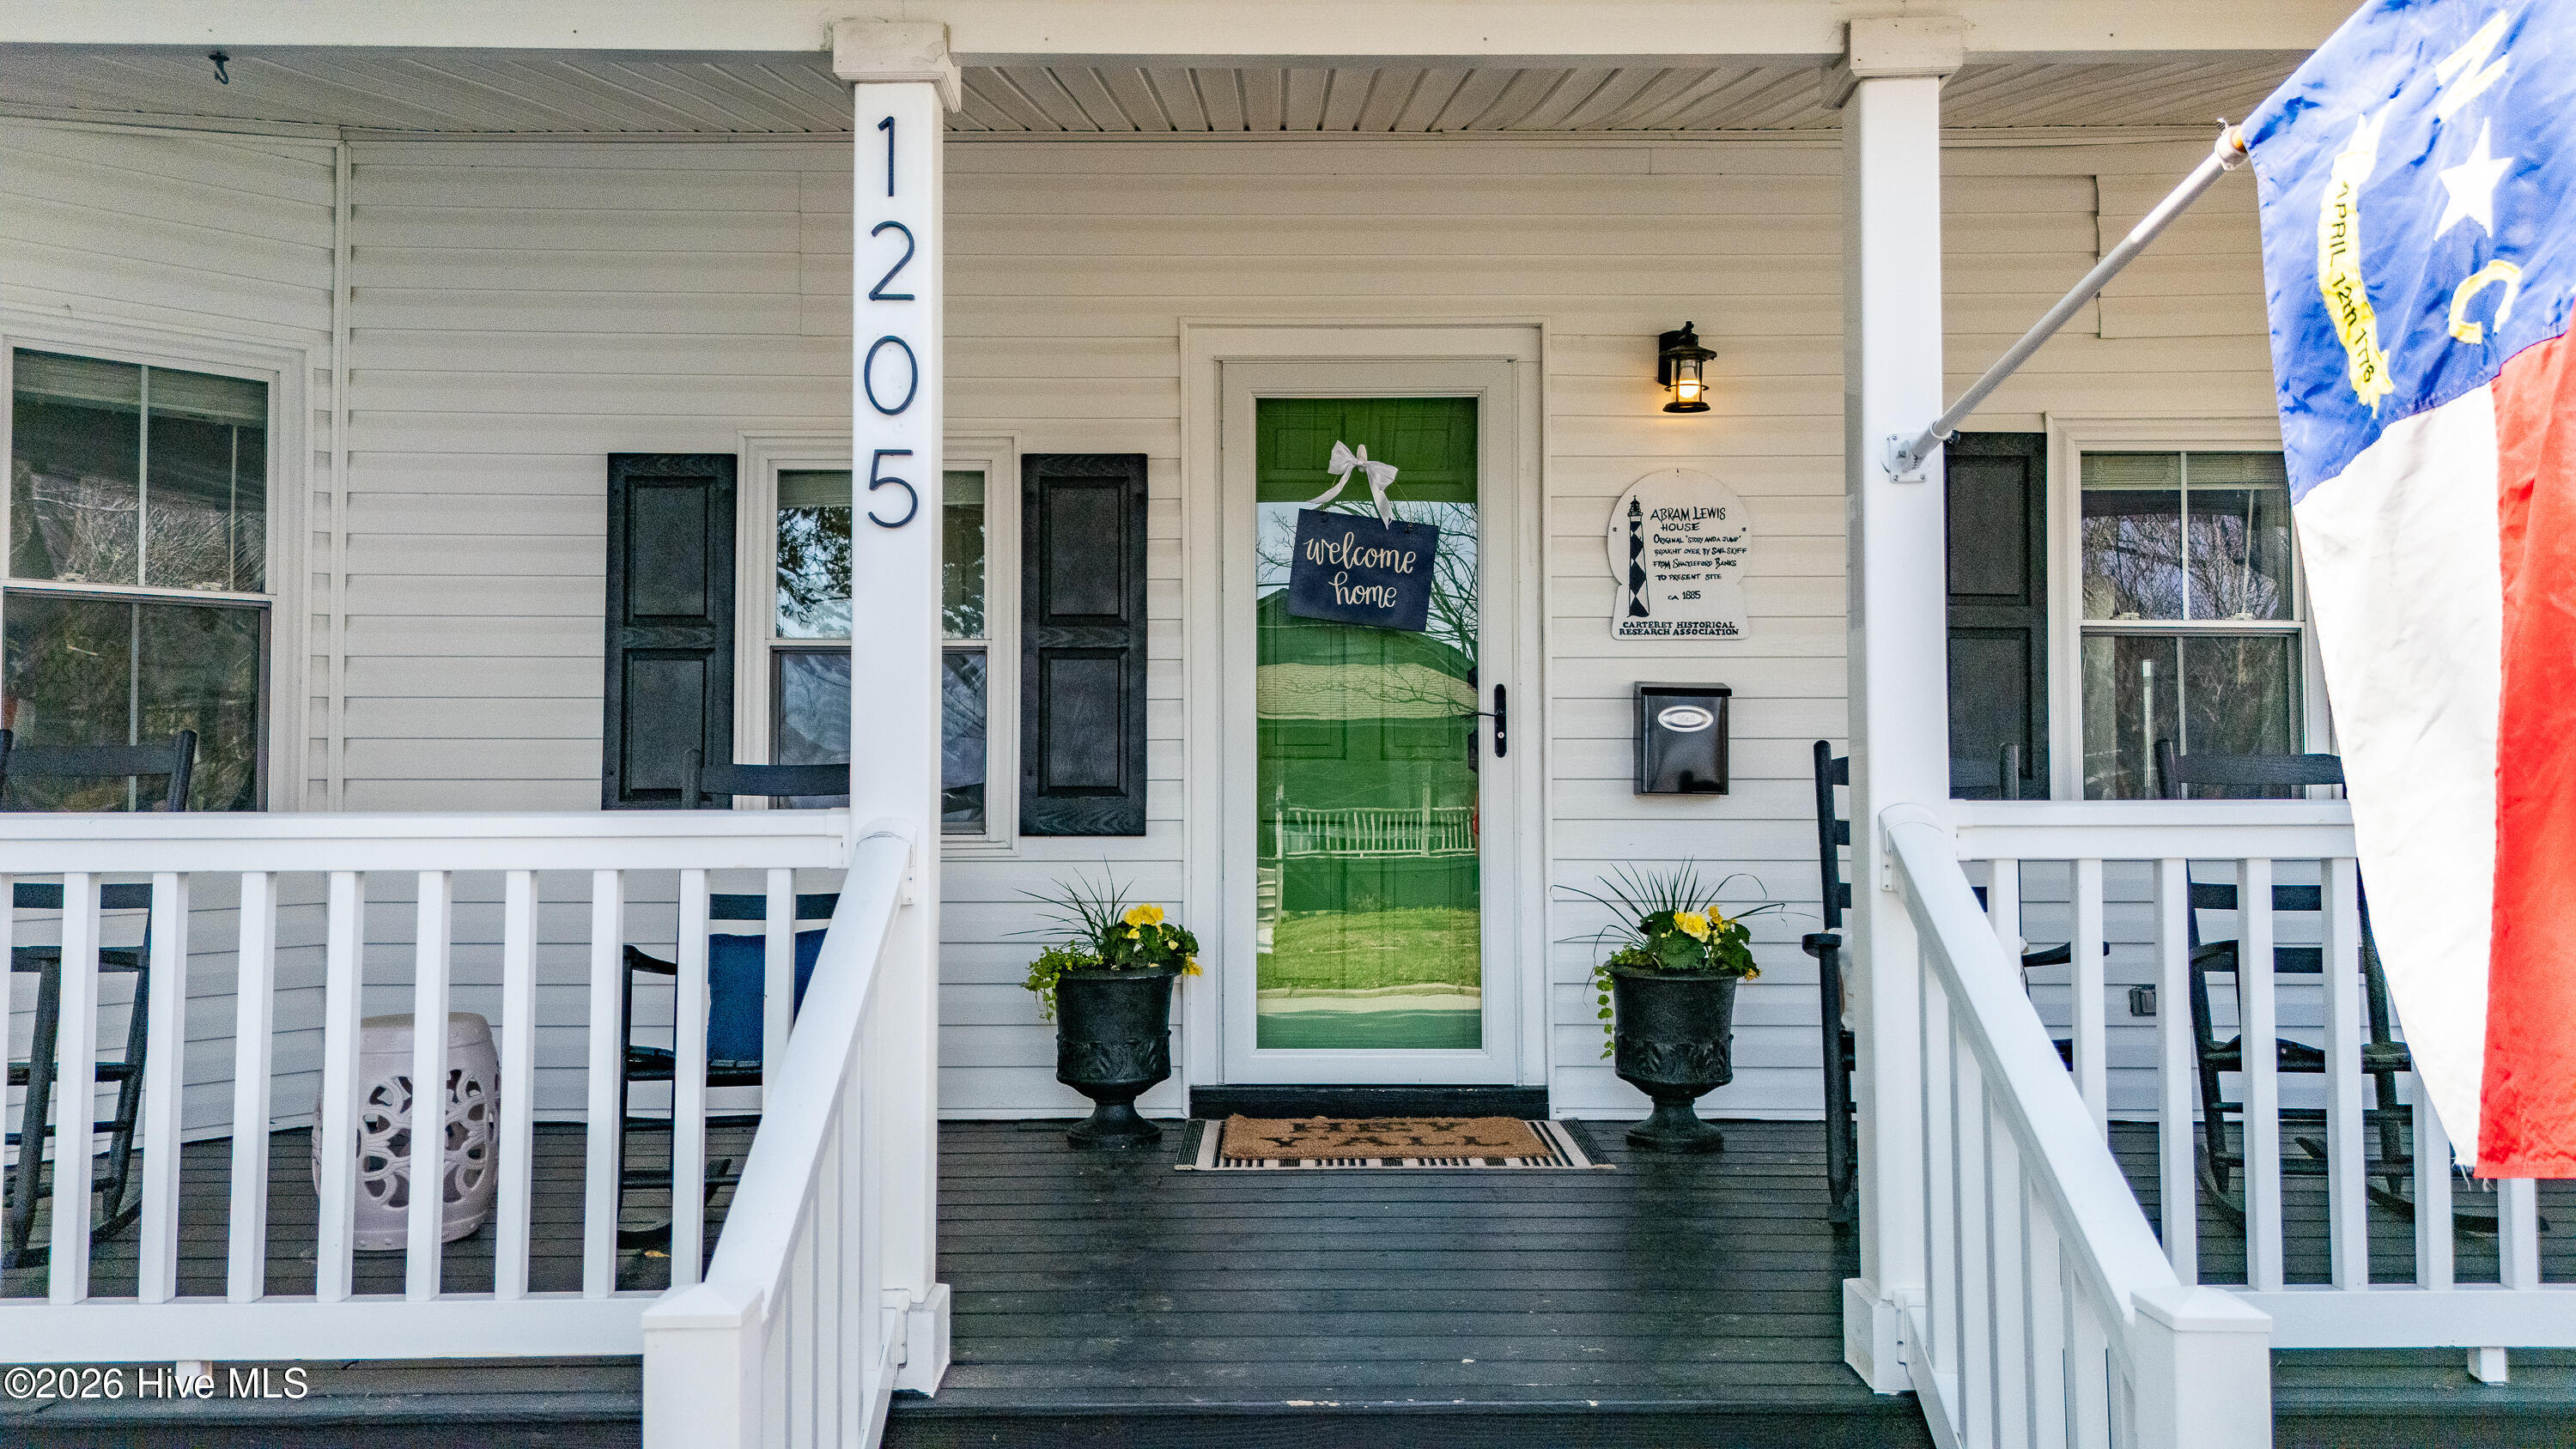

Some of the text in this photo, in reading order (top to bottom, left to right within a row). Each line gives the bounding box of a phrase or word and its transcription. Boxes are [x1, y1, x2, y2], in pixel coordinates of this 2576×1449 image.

[2435, 9, 2509, 124] N
[2330, 181, 2349, 267] APRIL
[2354, 327, 2375, 383] 1776
[2448, 258, 2522, 345] C
[864, 116, 919, 529] 1205
[1650, 506, 1726, 523] ABRAM LEWIS
[1660, 521, 1700, 531] HOUSE
[1303, 531, 1416, 573] welcome
[1653, 561, 1671, 569] FROM
[1714, 558, 1737, 569] BANKS
[1328, 571, 1397, 609] home
